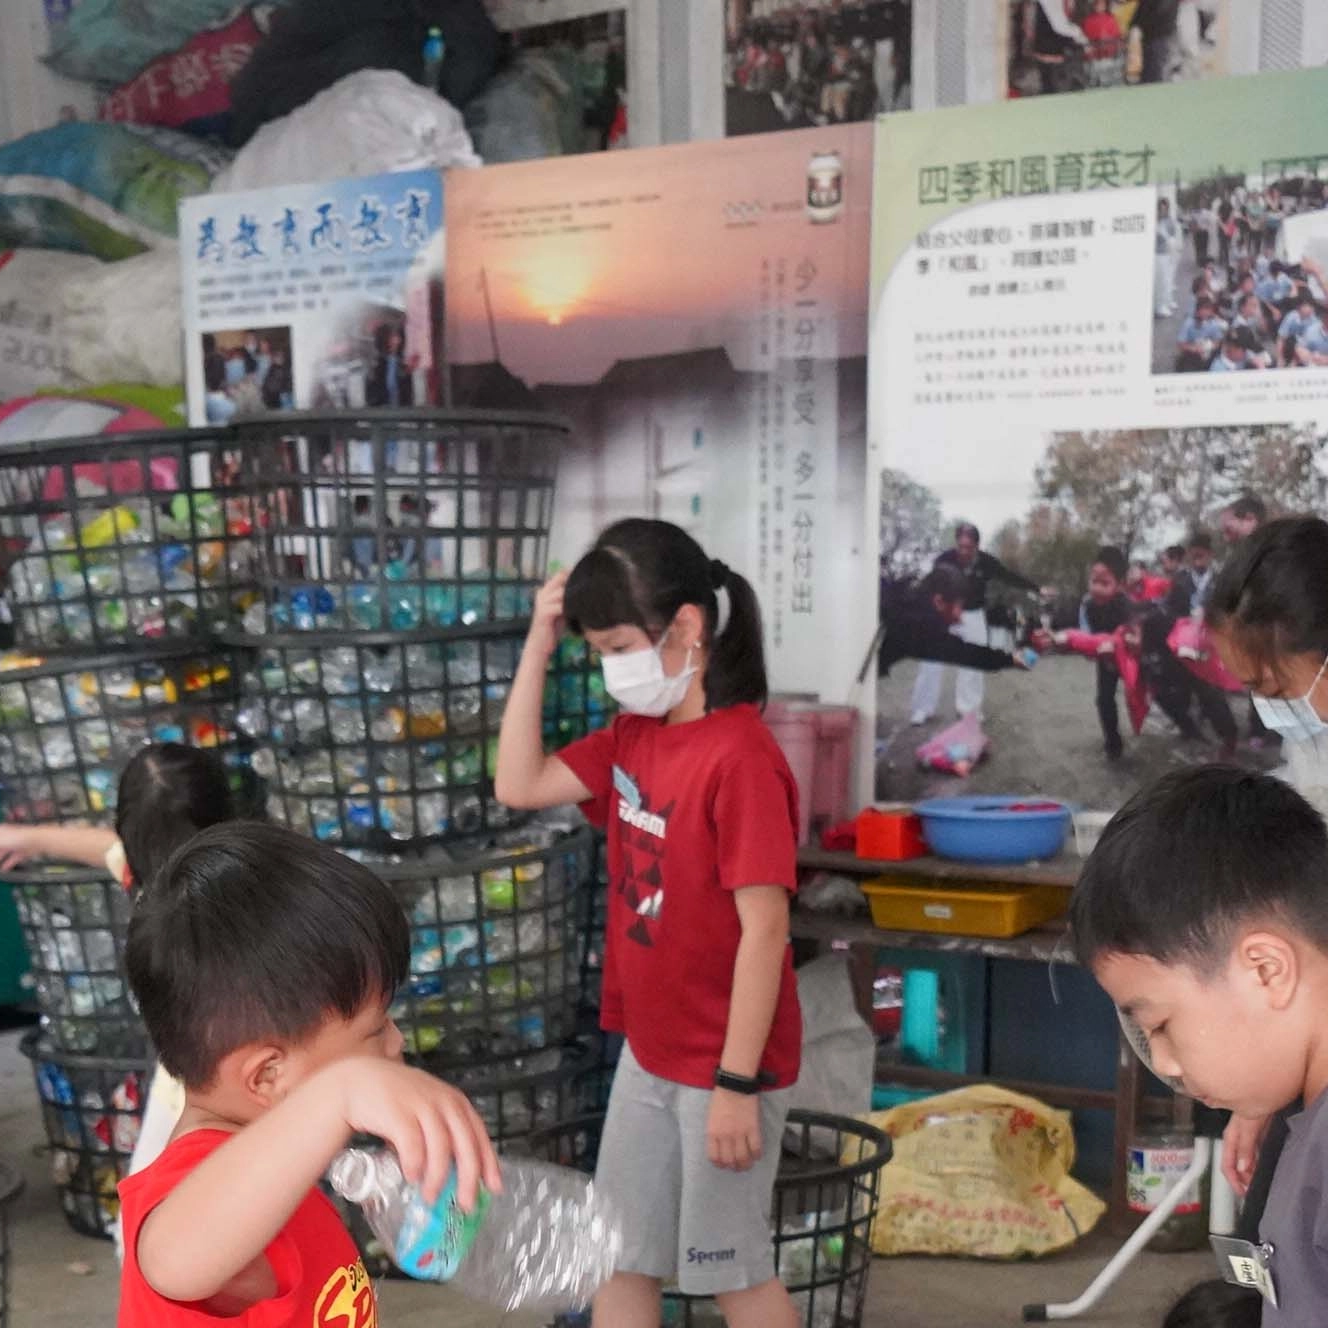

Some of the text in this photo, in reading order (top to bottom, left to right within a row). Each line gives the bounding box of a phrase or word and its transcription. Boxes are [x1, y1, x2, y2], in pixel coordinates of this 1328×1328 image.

[918, 144, 1156, 206] 四季和風育英才
[686, 1247, 736, 1264] Sprint
